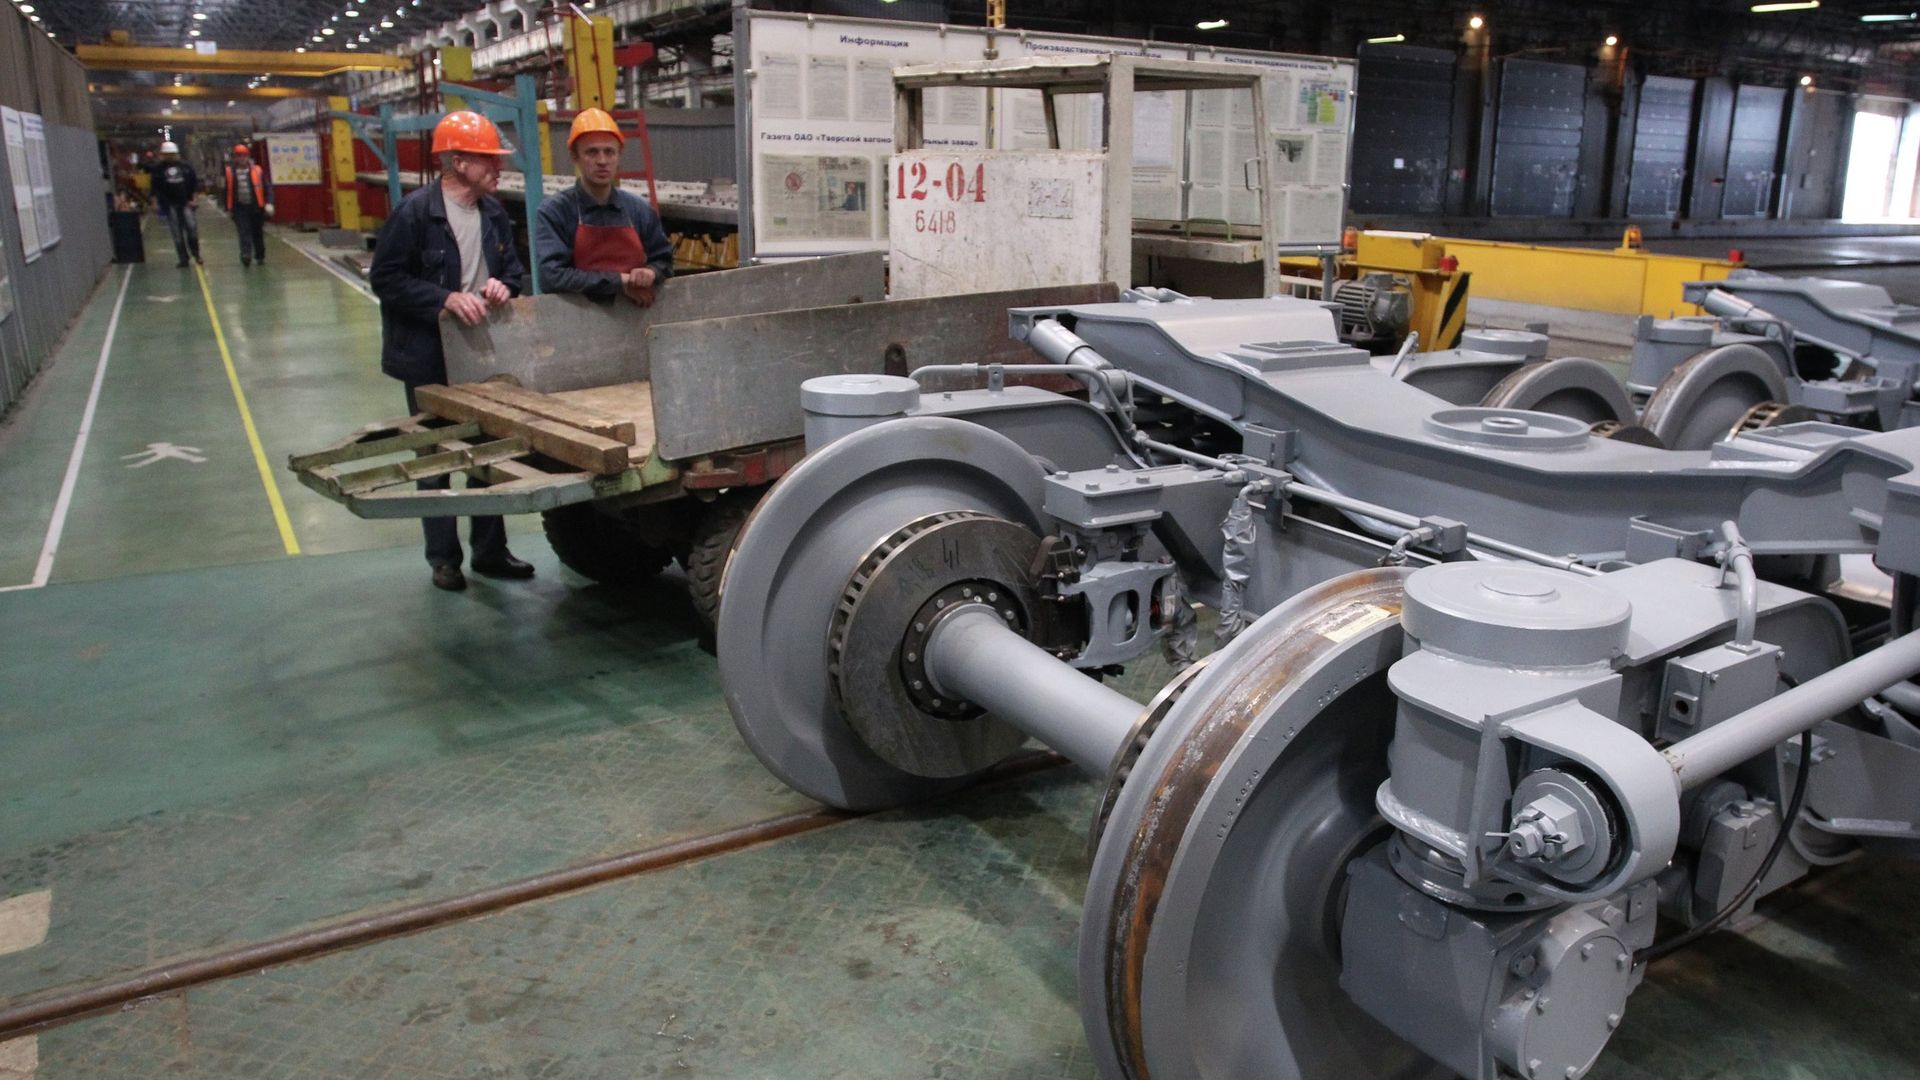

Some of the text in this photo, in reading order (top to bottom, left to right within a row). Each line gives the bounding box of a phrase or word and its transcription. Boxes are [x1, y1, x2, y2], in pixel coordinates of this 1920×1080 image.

[840, 34, 910, 49] Информация
[760, 132, 792, 142] Газета
[793, 133, 813, 142] ОАО
[896, 161, 987, 203] 12-04
[915, 209, 957, 235] 6418
